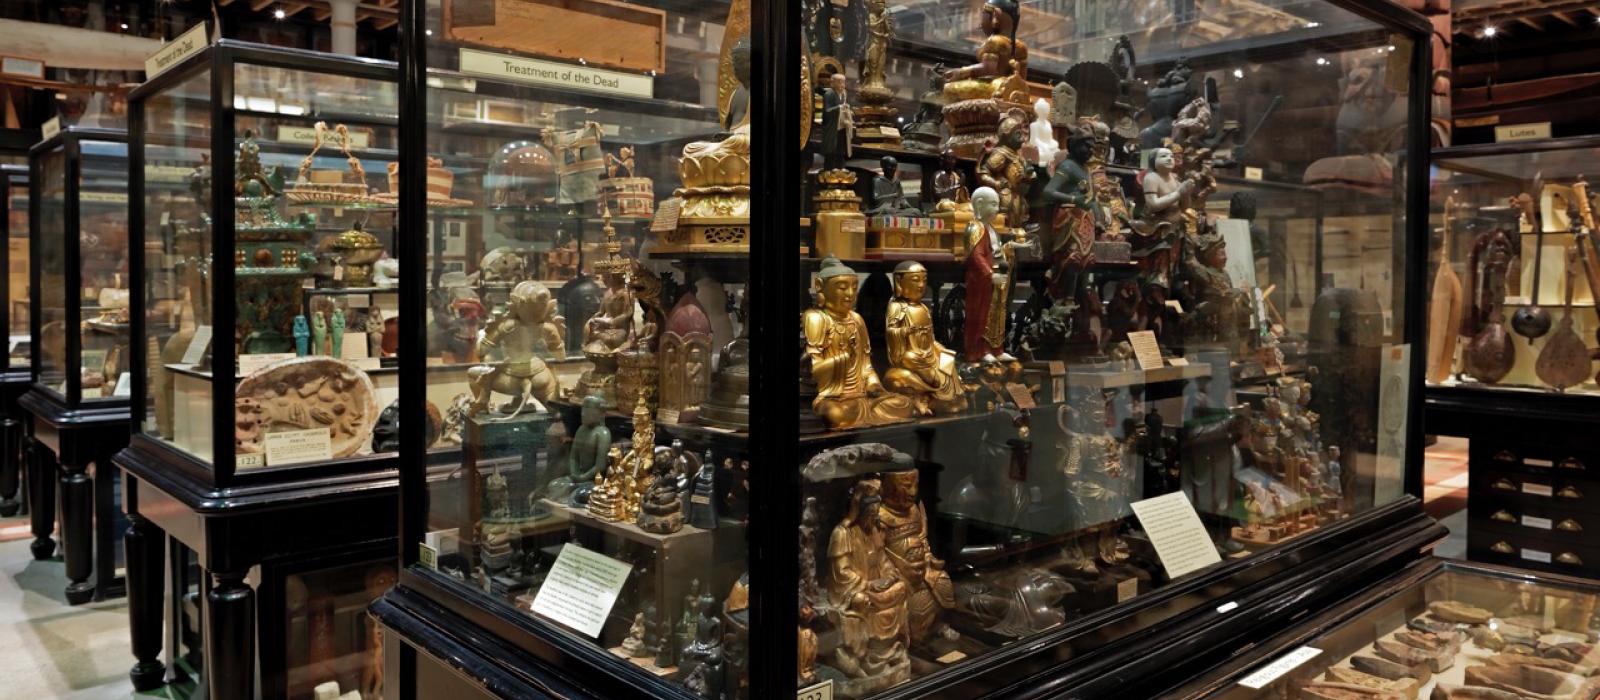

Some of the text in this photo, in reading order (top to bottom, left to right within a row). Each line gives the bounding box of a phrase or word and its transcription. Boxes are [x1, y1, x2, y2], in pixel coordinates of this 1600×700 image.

[503, 61, 619, 89] Treatment of the Dead
[1510, 128, 1536, 138] Lutes
